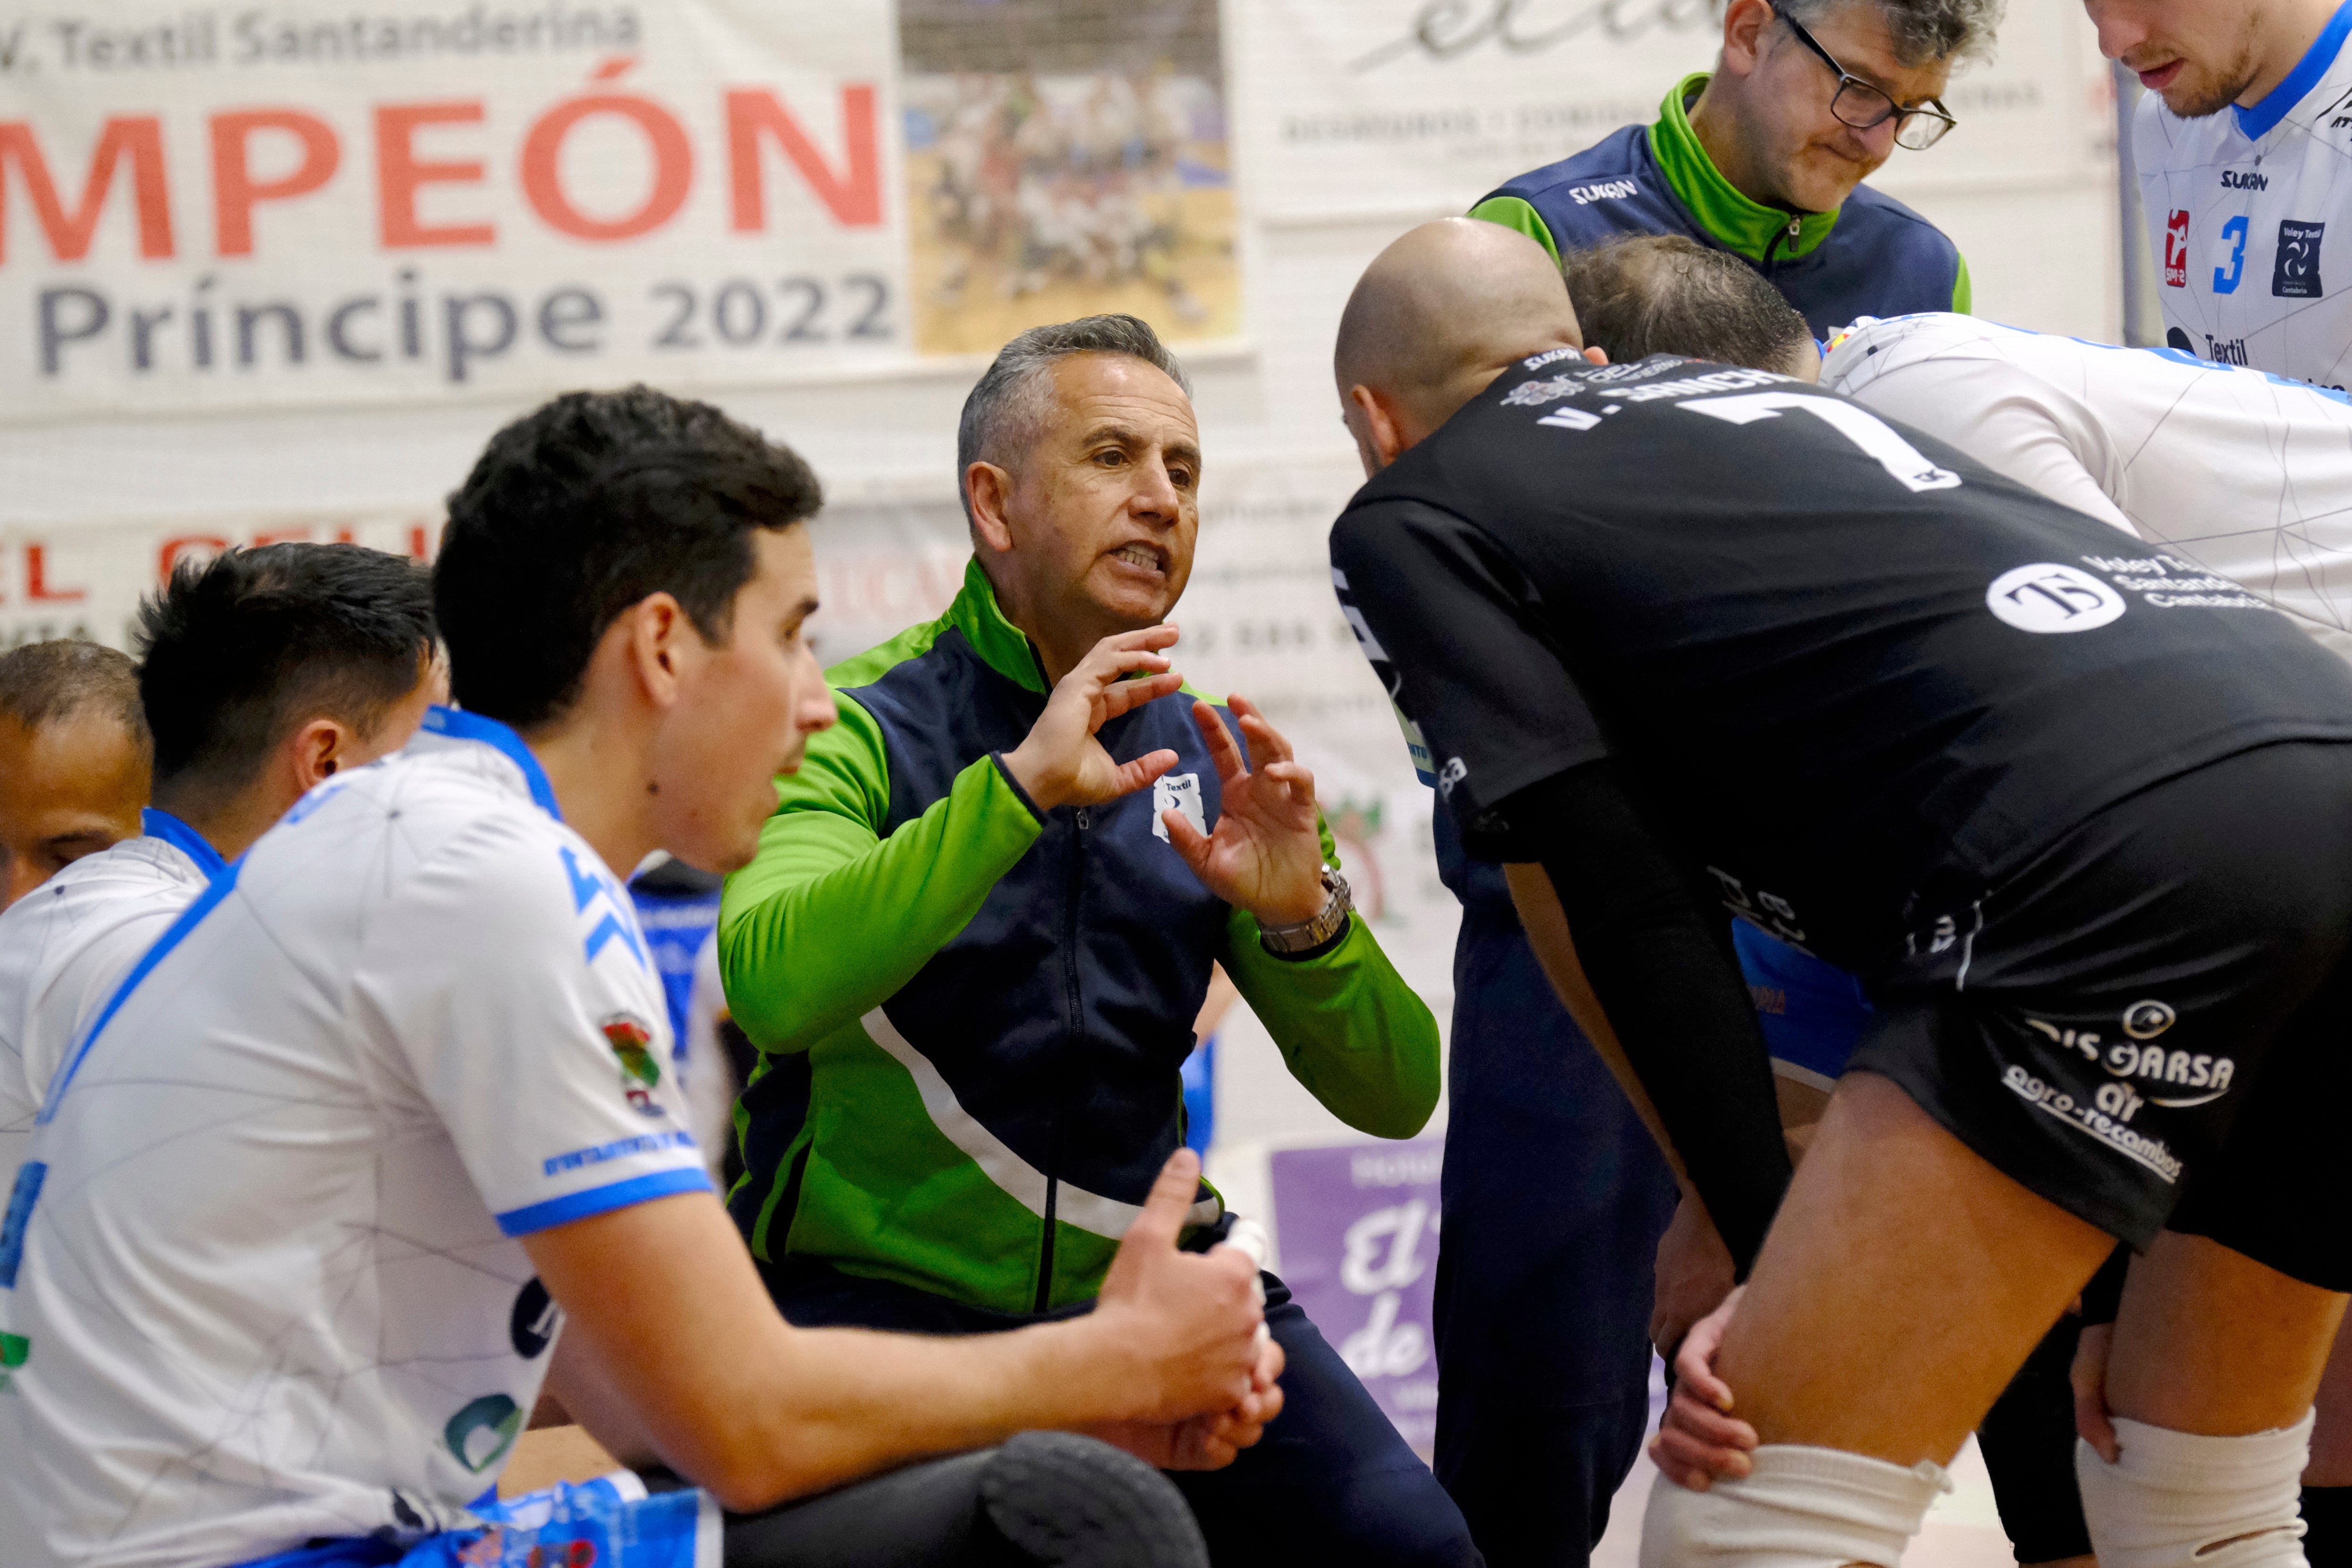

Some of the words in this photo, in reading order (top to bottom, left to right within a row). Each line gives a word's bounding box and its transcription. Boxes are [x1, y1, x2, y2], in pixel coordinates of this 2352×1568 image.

[51, 15, 214, 69] Textil
[236, 5, 641, 64] Santanderina
[0, 57, 882, 265] MPEÓN
[1569, 180, 1638, 205] SUKAN
[2221, 171, 2269, 191] SUKAN
[2213, 215, 2249, 295] 3
[2284, 227, 2304, 240] Voley
[2305, 229, 2322, 238] Textil
[39, 270, 603, 381] Príncipe
[652, 275, 893, 349] 2022
[2205, 334, 2248, 366] Textil
[1536, 403, 1622, 431] V.
[1598, 368, 1808, 402] SANCH
[2080, 555, 2167, 576] Voley
[1166, 779, 1192, 792] Textil
[1340, 1197, 1429, 1296] El
[1339, 1289, 1431, 1380] de
